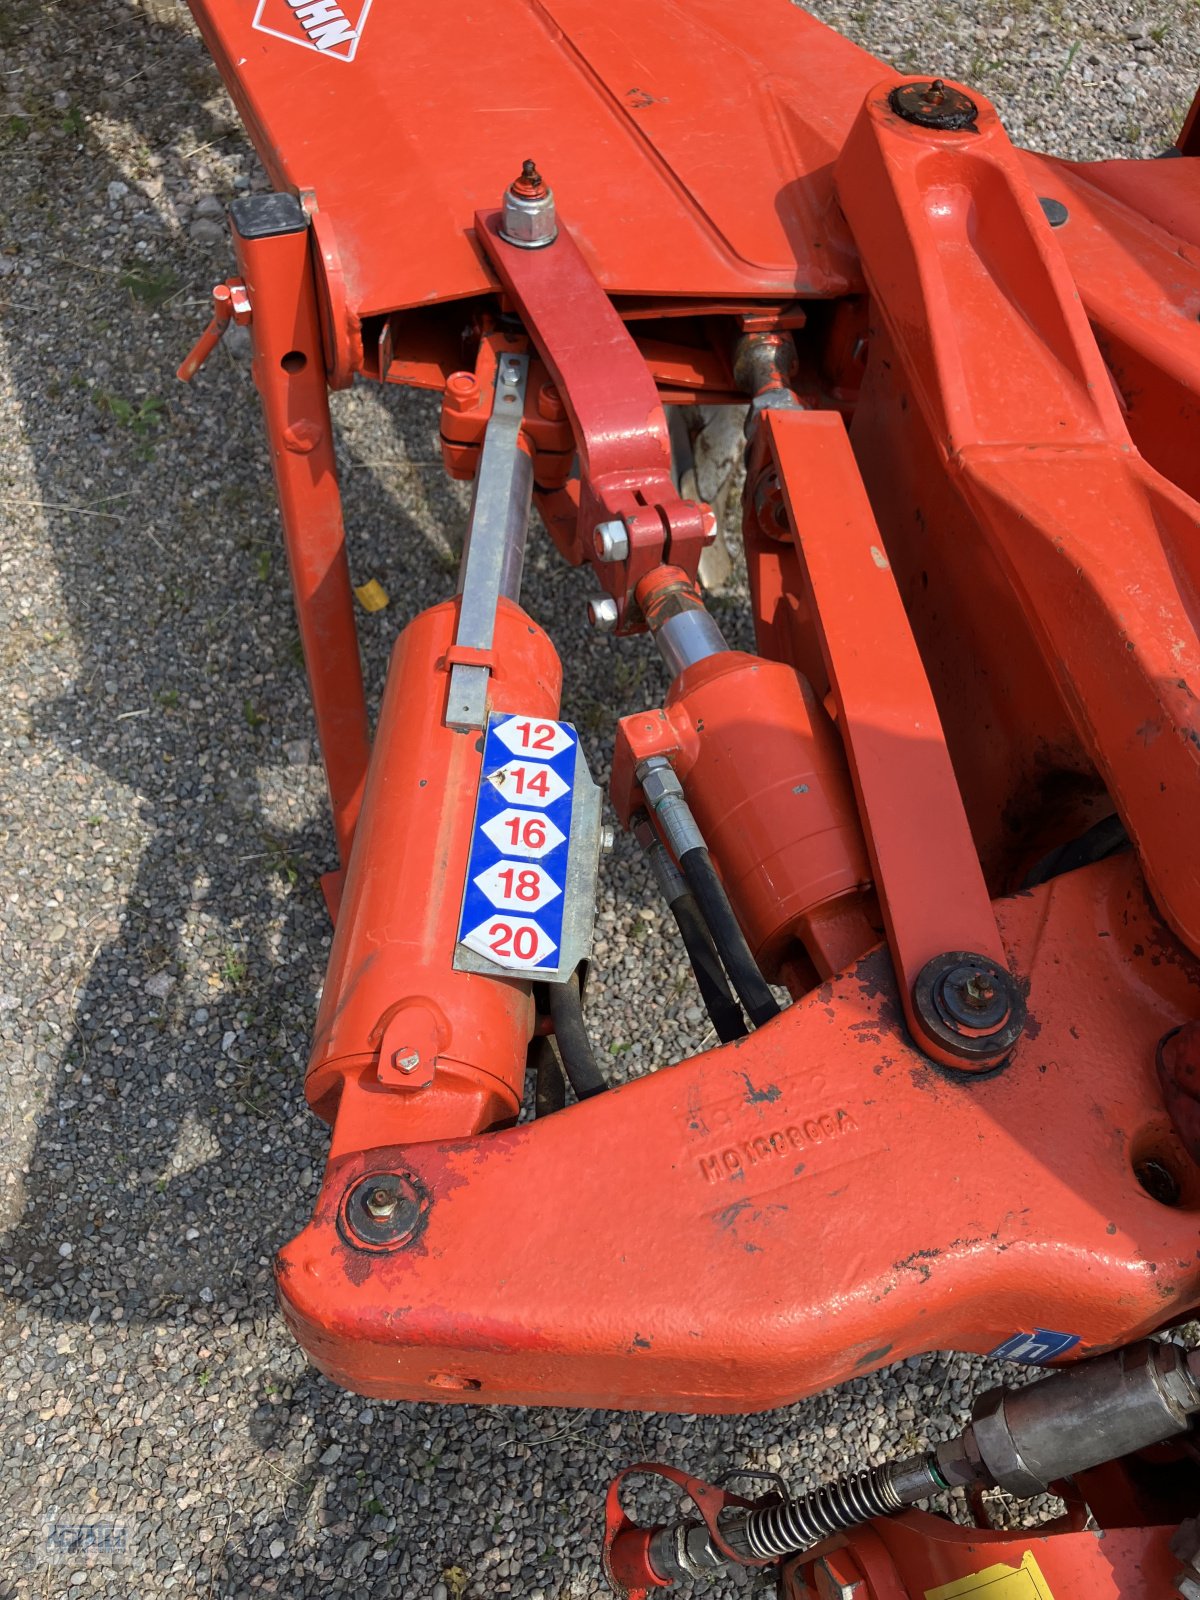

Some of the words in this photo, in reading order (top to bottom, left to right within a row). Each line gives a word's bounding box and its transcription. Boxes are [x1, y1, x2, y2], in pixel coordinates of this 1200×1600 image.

[516, 721, 556, 751] 12
[510, 767, 551, 798] 14
[504, 816, 547, 849] 16
[498, 868, 541, 902] 18
[488, 922, 539, 960] 20
